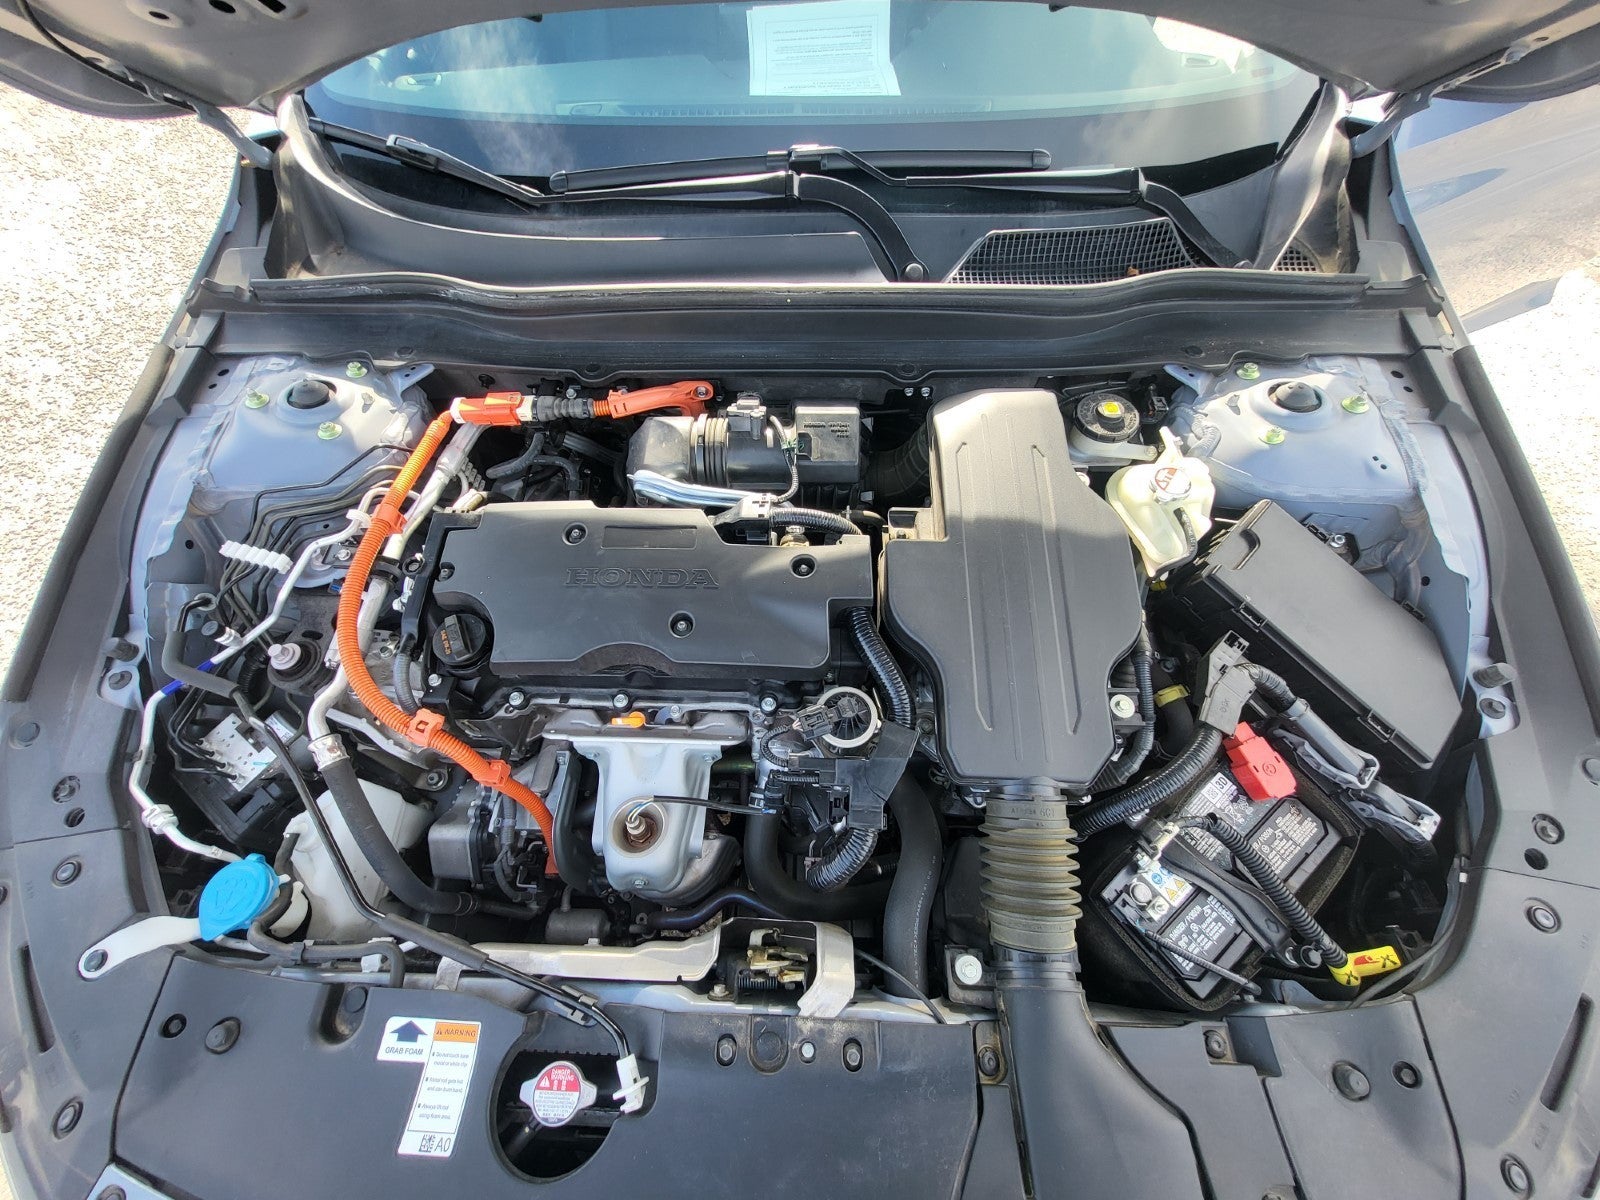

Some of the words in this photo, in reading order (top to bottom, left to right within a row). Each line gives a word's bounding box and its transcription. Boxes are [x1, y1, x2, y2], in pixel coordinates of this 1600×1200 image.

[565, 567, 720, 589] HONDA
[1215, 776, 1228, 790] 3D
[444, 1029, 477, 1038] WARNING
[385, 1046, 404, 1055] GRAB
[404, 1047, 424, 1056] FOAM
